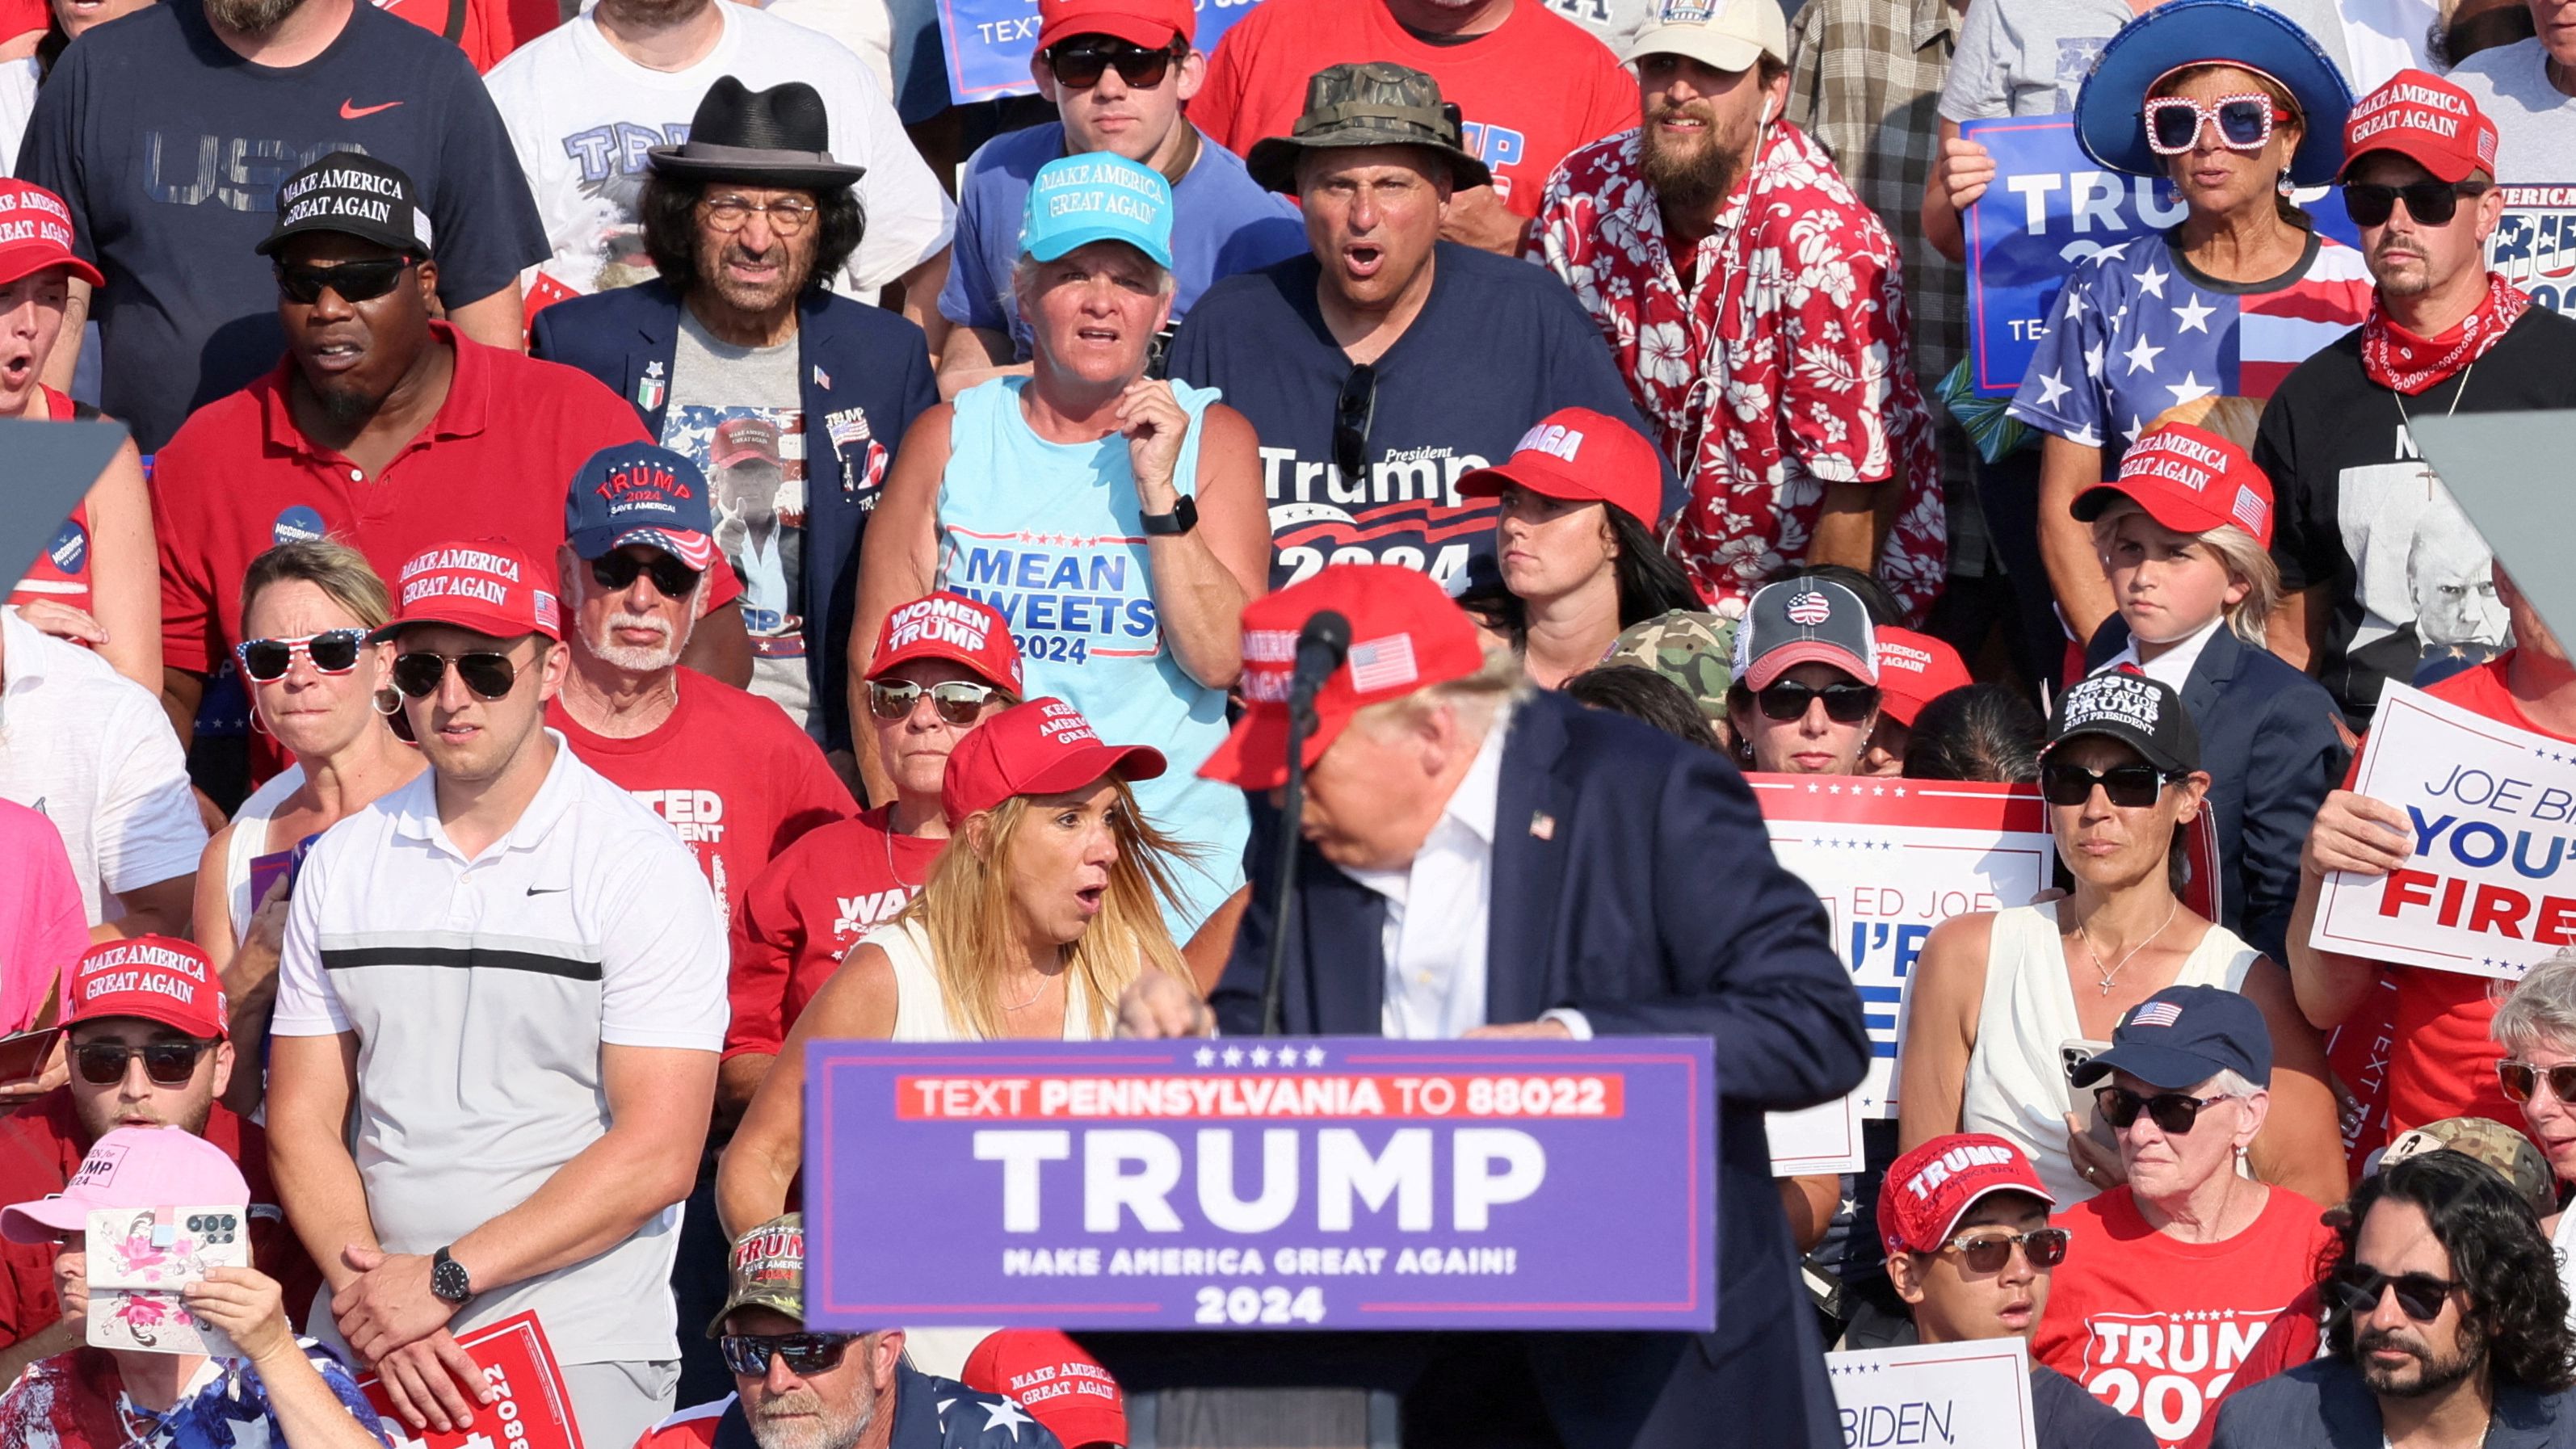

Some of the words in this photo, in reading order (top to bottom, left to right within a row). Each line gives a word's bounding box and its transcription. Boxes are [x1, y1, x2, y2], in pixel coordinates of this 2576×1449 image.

[2347, 89, 2389, 124] MAKE
[2388, 83, 2469, 116] AMERICA
[2352, 110, 2400, 144] GREAT
[2401, 109, 2458, 139] AGAIN
[143, 131, 370, 212] US
[283, 172, 318, 207] MAKE
[321, 169, 403, 200] AMERICA
[1040, 164, 1090, 193] MAKE
[1090, 163, 1165, 205] AMERICA
[284, 197, 330, 226] GREAT
[331, 197, 391, 224] AGAIN
[1050, 191, 1105, 218] GREAT
[1105, 194, 1156, 225] AGAIN
[1385, 446, 1454, 462] President
[2149, 432, 2228, 474] AMERICA
[595, 466, 693, 501] TRUMP
[2150, 458, 2211, 493] AGAIN
[611, 502, 632, 514] SAVE
[634, 502, 675, 513] AMERICA!
[625, 490, 662, 502] 2024
[399, 551, 439, 583] MAKE
[435, 549, 519, 582] AMERICA
[965, 548, 1127, 592] MEAN
[403, 576, 448, 606] GREAT
[447, 577, 507, 605] AGAIN
[891, 598, 991, 635] WOMEN
[924, 615, 952, 624] FOR
[889, 620, 985, 653] TRUMP
[1881, 655, 1926, 674] AGAIN
[2069, 675, 2162, 702] JESUS
[2103, 688, 2159, 713] SAVIOR
[2065, 697, 2159, 724] TRUMP
[2071, 714, 2089, 727] MY
[2090, 711, 2155, 736] PRESIDENT
[2424, 764, 2533, 814] JOE
[1918, 889, 1995, 919] JOE
[2378, 867, 2576, 947] FIRE
[79, 947, 126, 977] MAKE
[125, 944, 206, 983] AMERICA
[86, 972, 138, 1000] GREAT
[138, 972, 195, 1005] AGAIN
[914, 1078, 1030, 1116] TEXT
[1039, 1077, 1384, 1115] PENNSYLVANIA
[1394, 1078, 1455, 1115] TO
[1465, 1077, 1606, 1115] 88022
[973, 1128, 1548, 1233] TRUMP
[1907, 1145, 2014, 1201] TRUMP
[1002, 1248, 1101, 1276] MAKE
[1108, 1248, 1266, 1276] AMERICA
[1274, 1248, 1386, 1276] GREAT
[1395, 1248, 1518, 1276] AGAIN!
[1194, 1285, 1326, 1325] 2024
[1010, 1366, 1056, 1390] MAKE
[1021, 1381, 1071, 1405] GREAT
[1076, 1380, 1114, 1400] AGAIN
